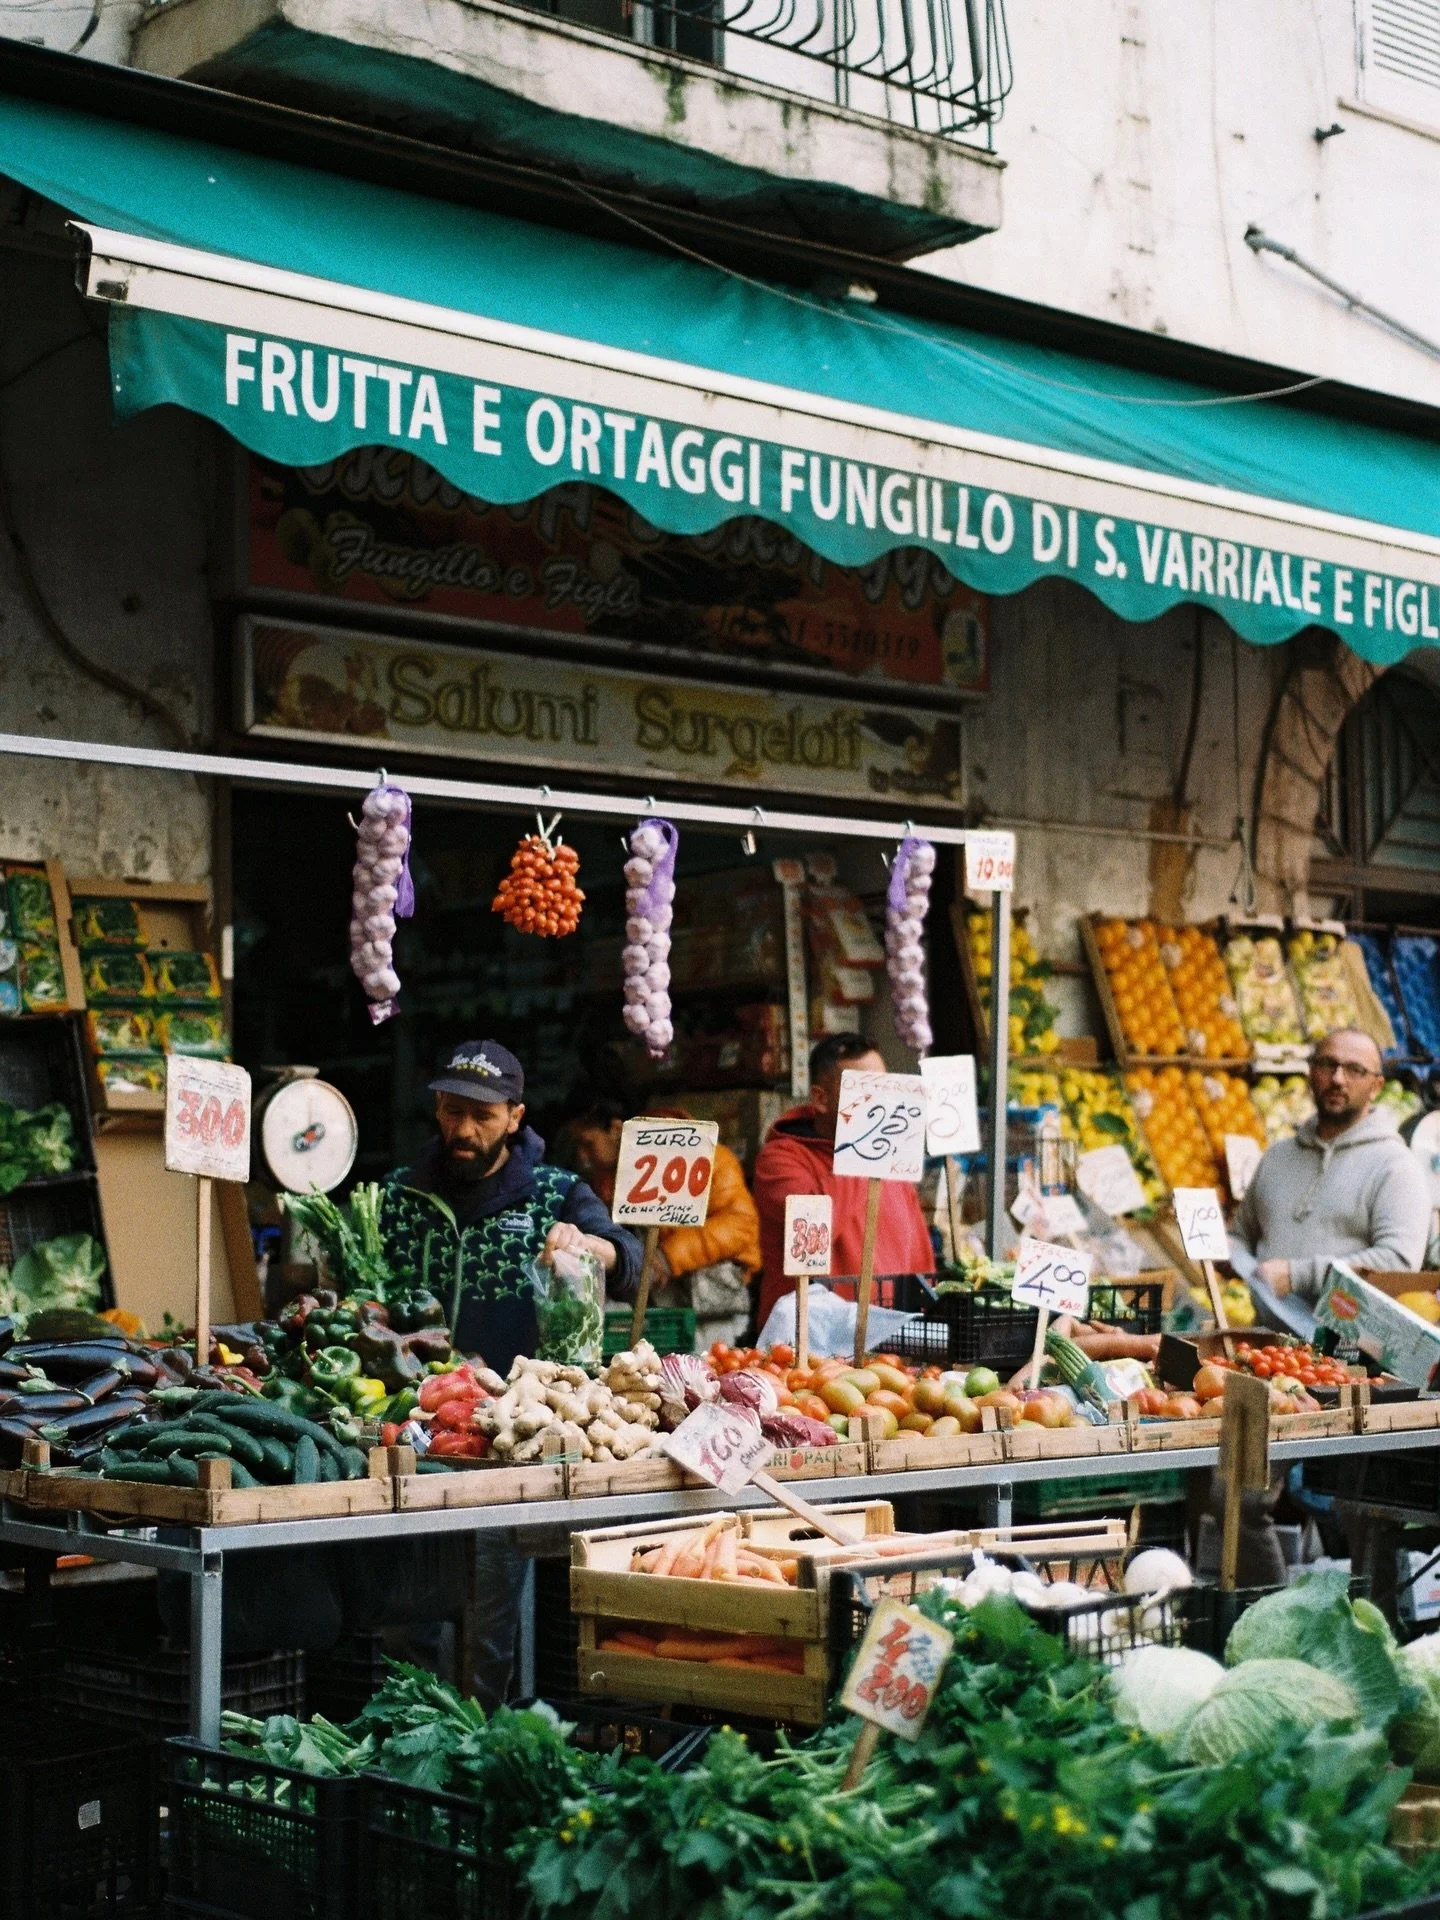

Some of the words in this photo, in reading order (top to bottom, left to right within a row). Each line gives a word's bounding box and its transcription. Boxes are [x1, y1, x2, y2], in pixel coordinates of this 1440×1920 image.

[226, 333, 448, 446] FRUTTA
[473, 384, 502, 456] E
[526, 397, 761, 507] ORTAGGI
[780, 450, 1015, 555] FUNGILLO
[1032, 502, 1079, 568] DI
[1094, 518, 1127, 579] S.
[1136, 525, 1322, 615] VARRIALE
[1334, 569, 1354, 624] E
[330, 526, 498, 600] Fungillo
[508, 570, 530, 594] e
[388, 654, 598, 746] Salumi
[636, 1126, 702, 1147] EURO
[626, 1154, 711, 1205] 2,00
[804, 1448, 844, 1465] PACK
